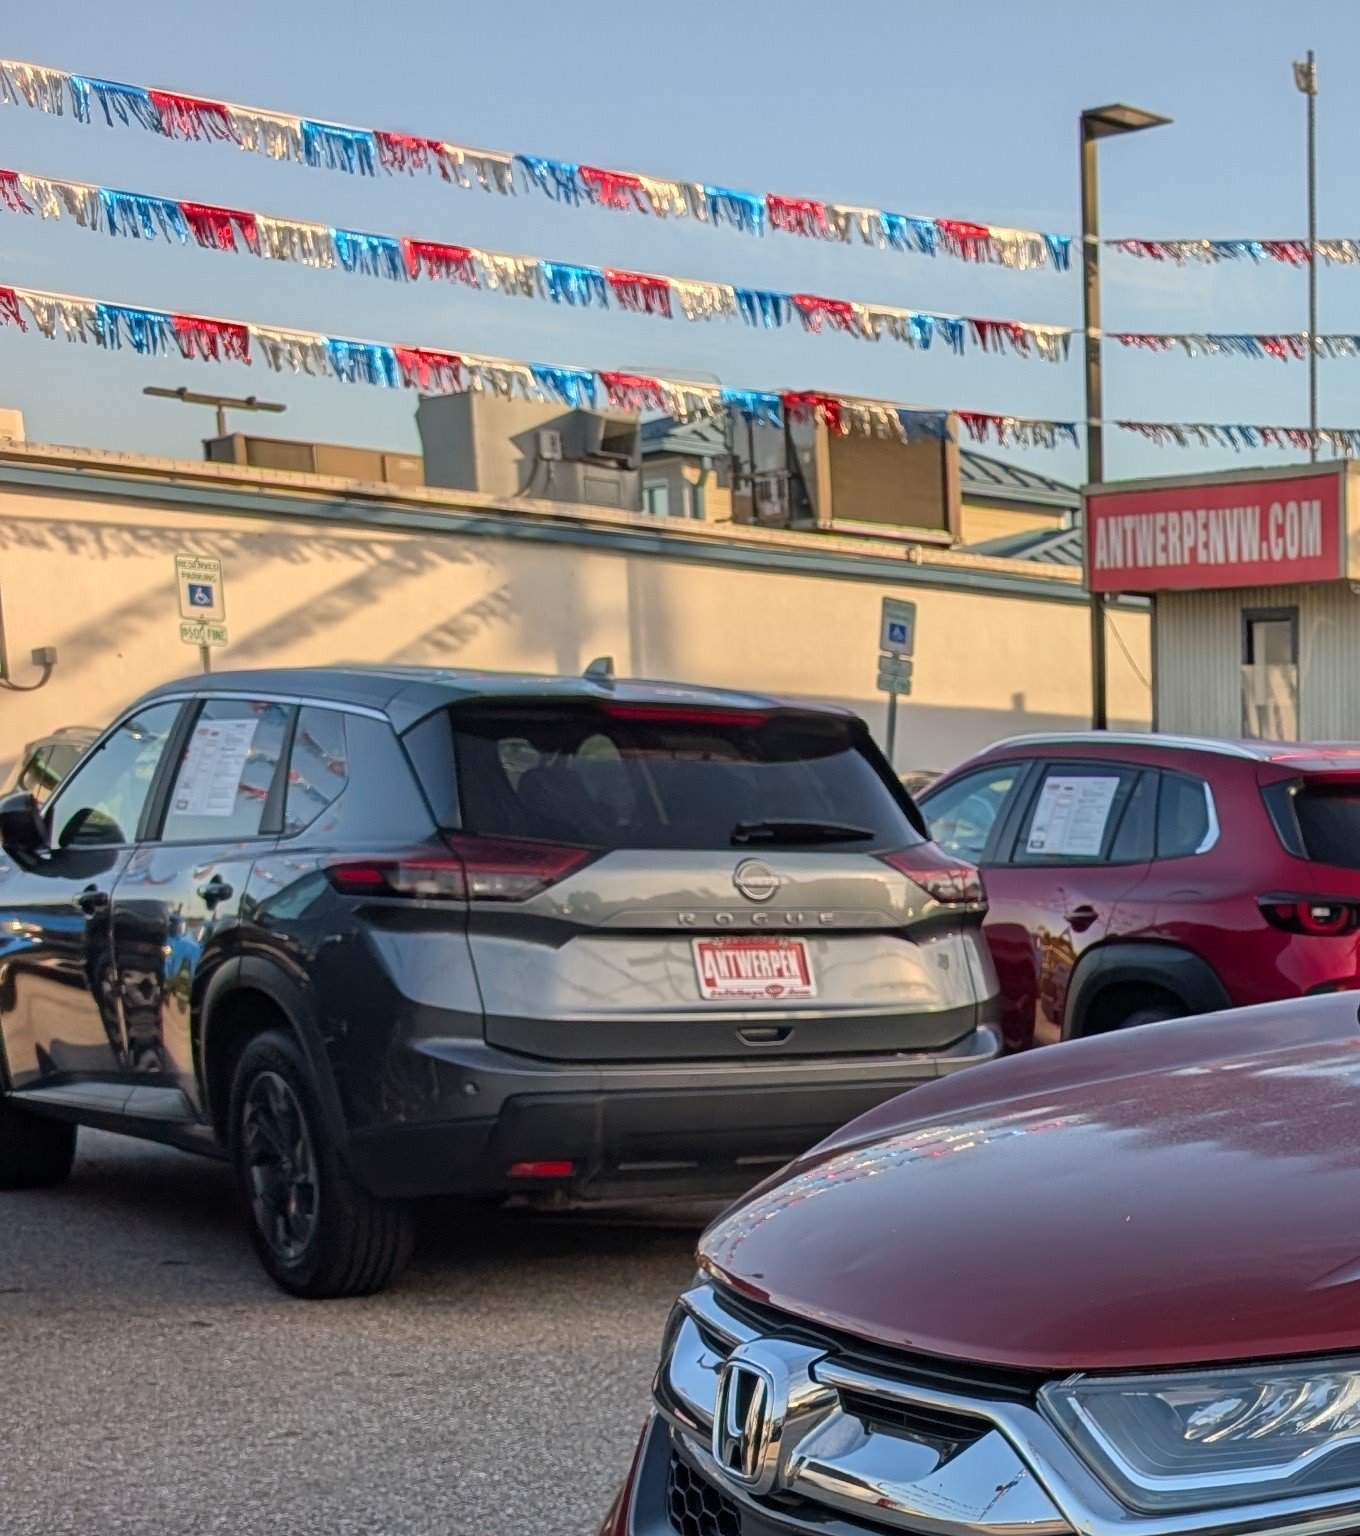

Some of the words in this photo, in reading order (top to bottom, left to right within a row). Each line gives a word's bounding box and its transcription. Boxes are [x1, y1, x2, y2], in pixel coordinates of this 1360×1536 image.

[1094, 499, 1322, 570] ANTWERPENVW.COM
[678, 911, 834, 926] ROGUE
[703, 949, 801, 980] ANTWERPEN
